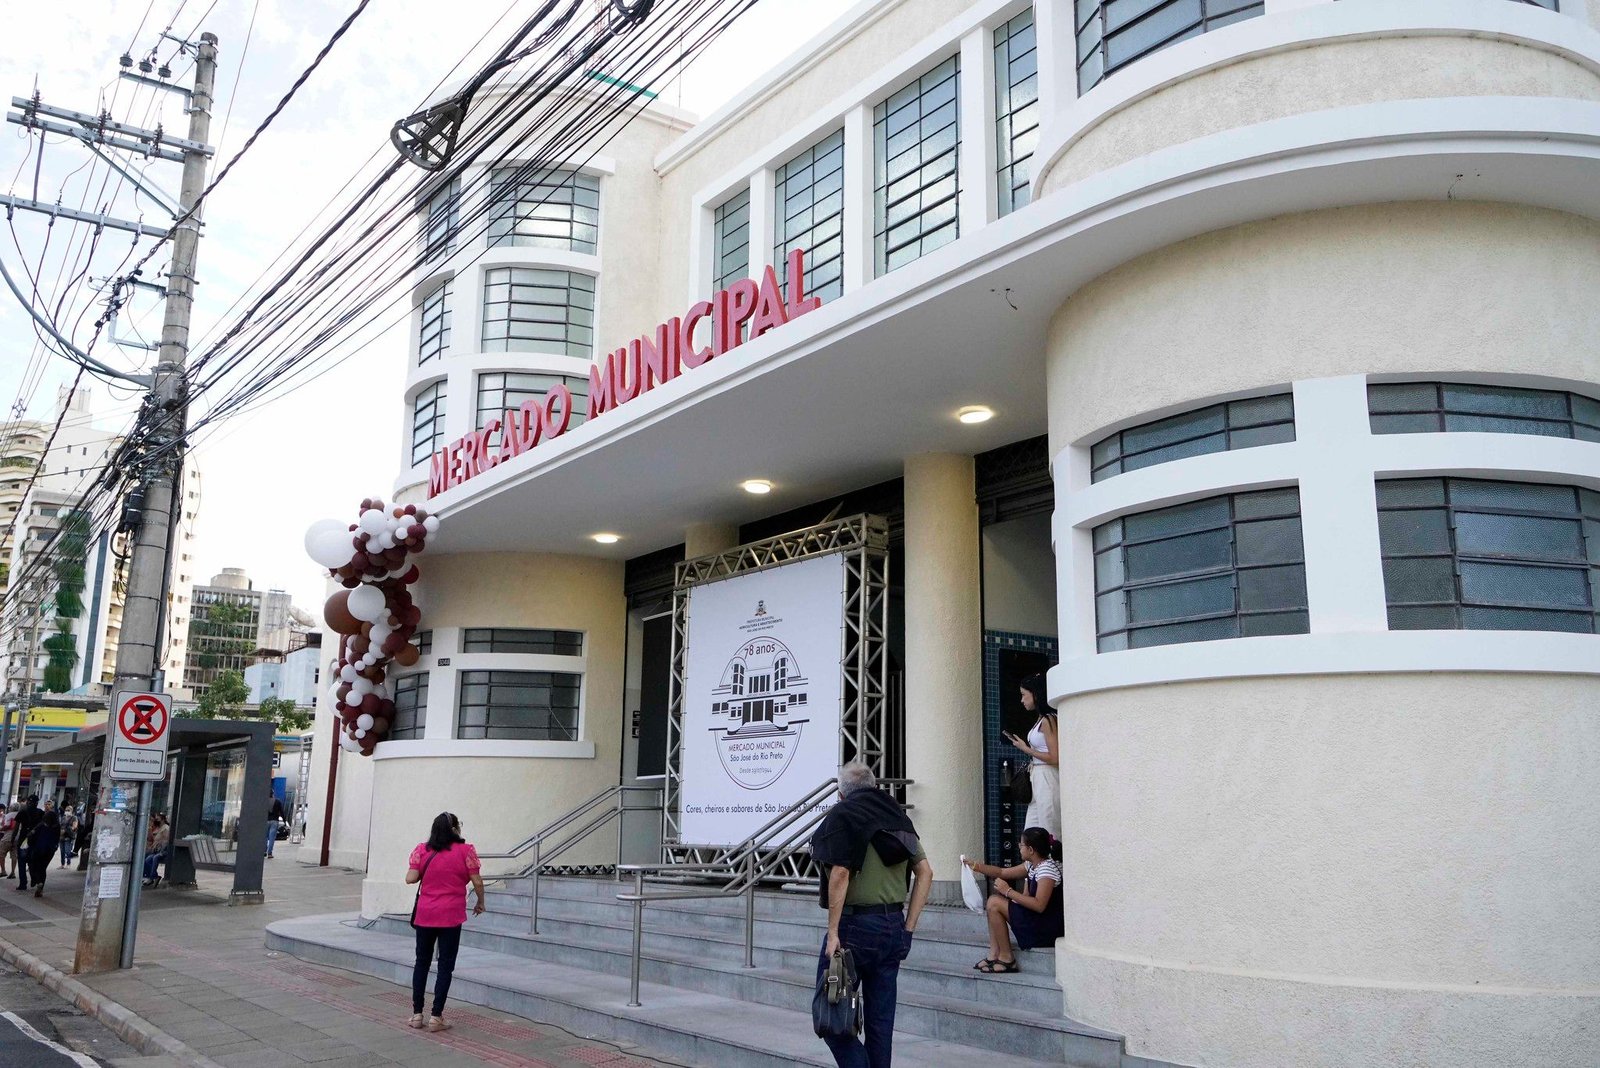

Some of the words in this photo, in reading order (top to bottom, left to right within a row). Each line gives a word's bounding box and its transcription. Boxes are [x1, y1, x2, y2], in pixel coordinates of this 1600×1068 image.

[427, 383, 572, 500] MERCADO
[586, 248, 821, 422] MUNICIPAL
[744, 644, 754, 659] 78
[756, 644, 776, 655] anos
[728, 742, 755, 752] MERCADO
[756, 740, 786, 750] MUNICIPAL
[740, 753, 751, 762] José
[760, 752, 769, 760] Rio
[770, 752, 784, 760] Preto
[686, 804, 703, 814] Cores,
[704, 804, 724, 813] cheiros
[731, 804, 754, 813] sabores
[754, 803, 762, 813] de
[764, 803, 776, 812] São
